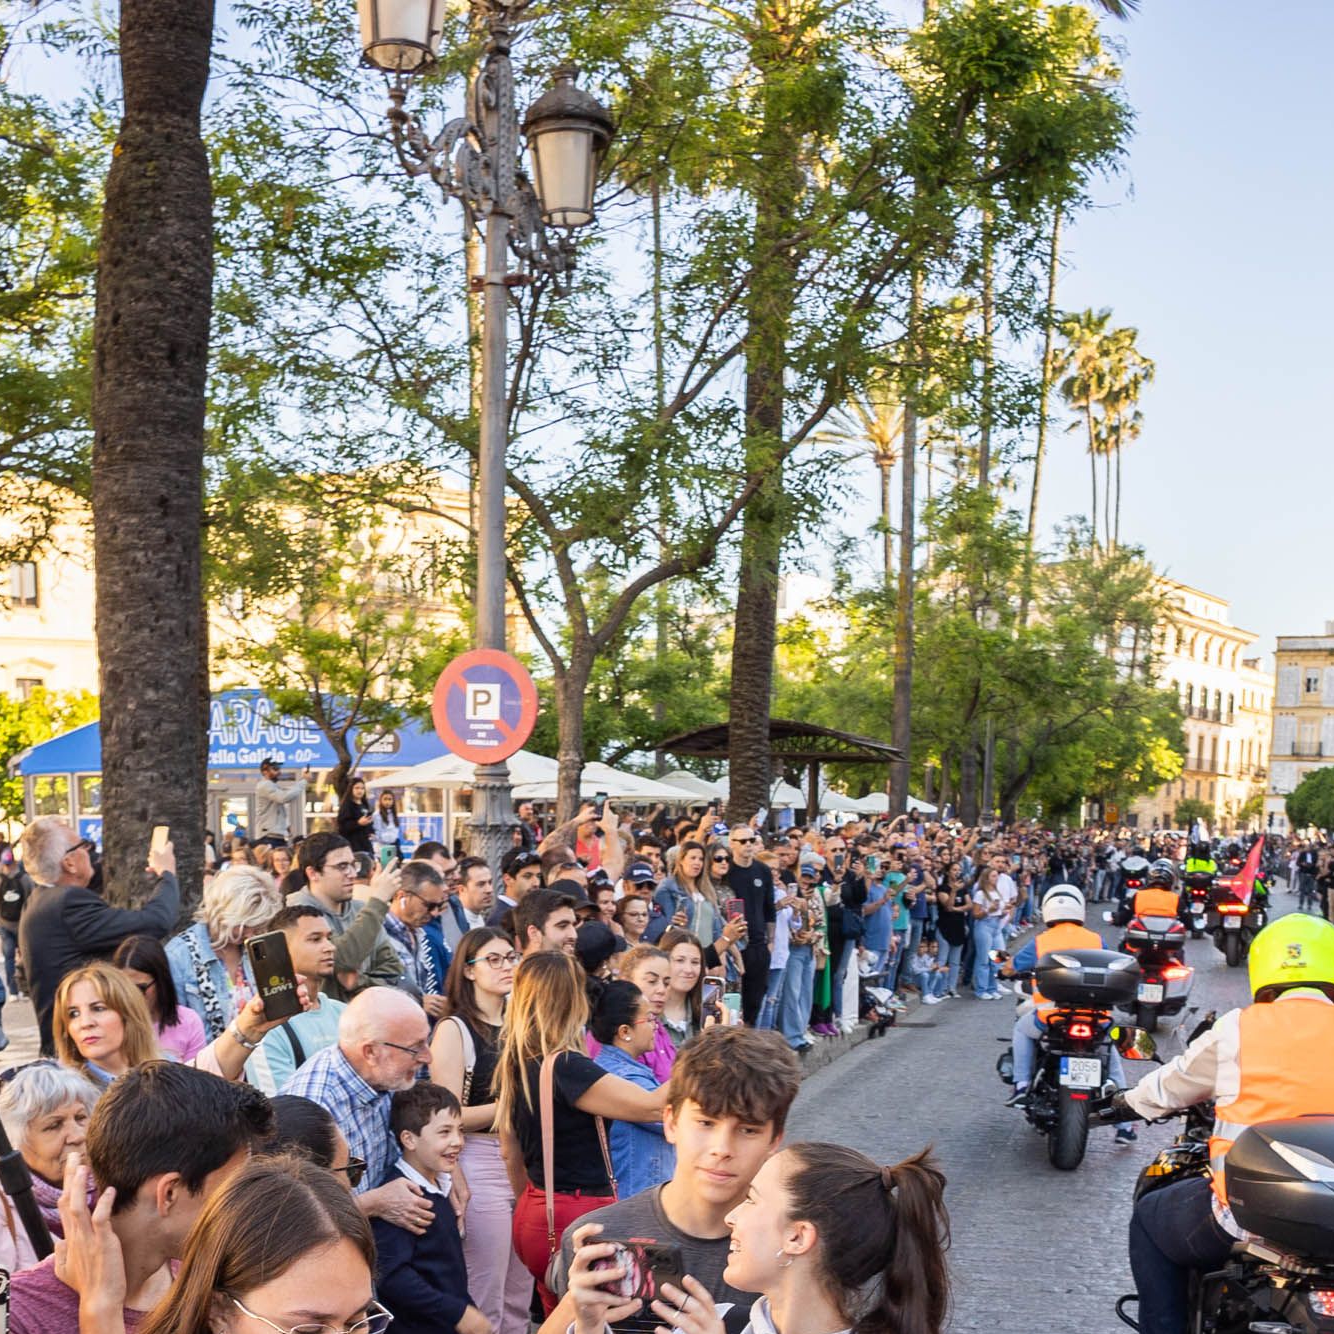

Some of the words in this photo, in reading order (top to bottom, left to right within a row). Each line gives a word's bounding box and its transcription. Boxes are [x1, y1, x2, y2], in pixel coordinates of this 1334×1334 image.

[472, 689, 492, 716] P
[207, 698, 321, 745] ARAGE
[262, 980, 294, 996] Lowi
